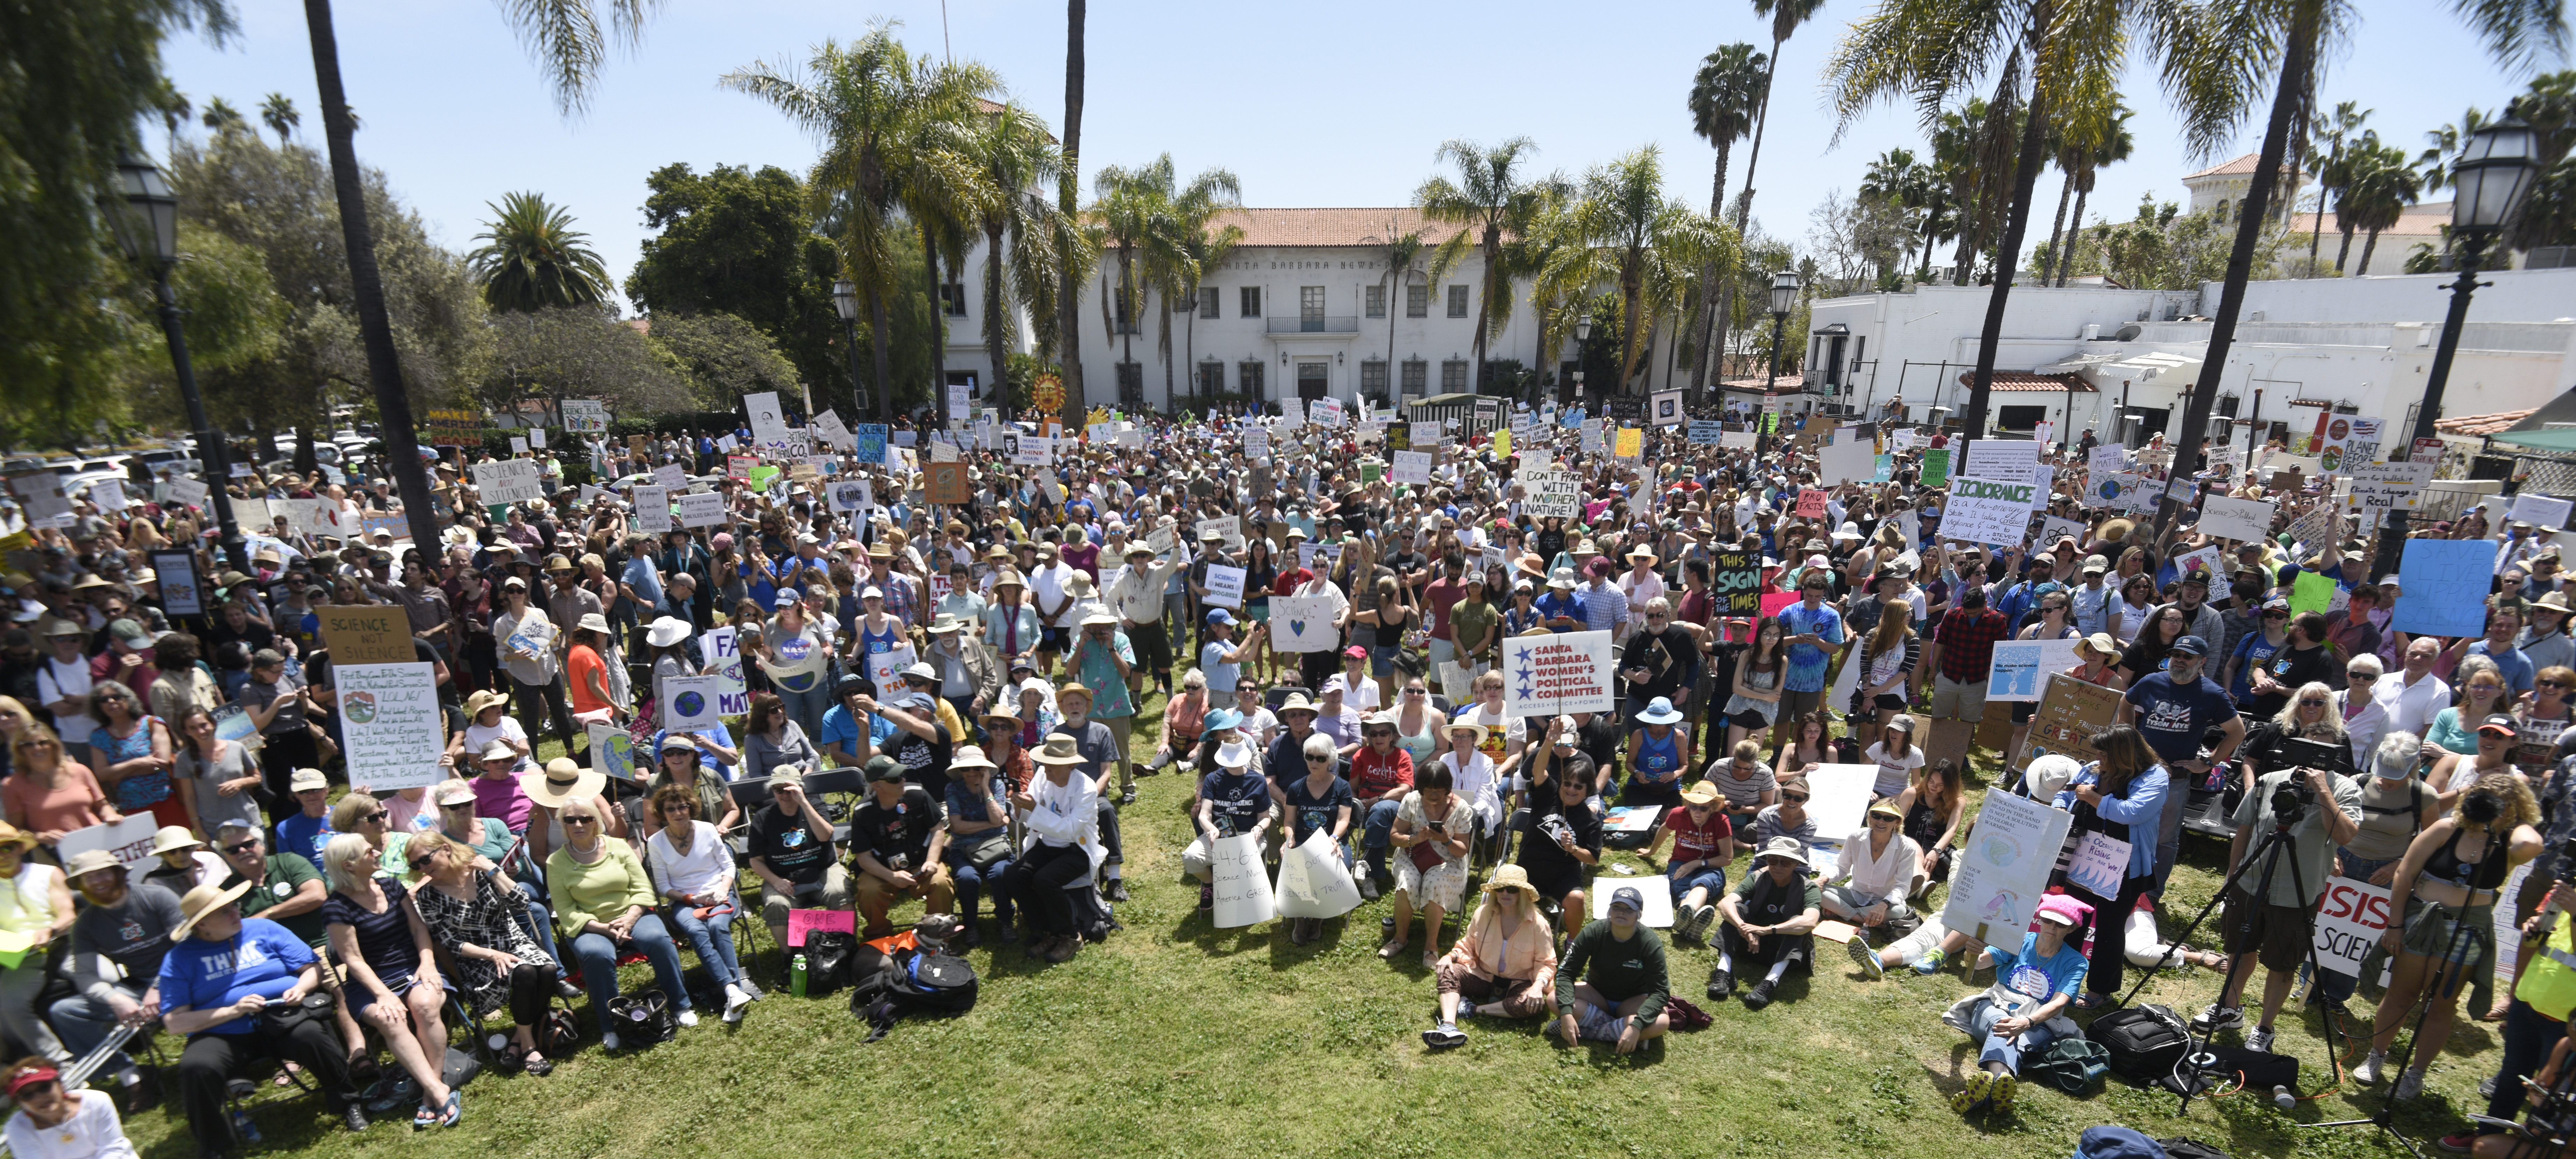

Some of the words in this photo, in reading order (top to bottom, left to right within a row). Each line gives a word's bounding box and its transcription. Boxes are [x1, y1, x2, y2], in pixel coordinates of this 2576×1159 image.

[1217, 262, 1259, 270] ANTA
[1272, 262, 1330, 271] BARBARA
[429, 410, 470, 420] MAKE
[429, 420, 481, 429] AMERICA
[860, 424, 887, 435] SCIENCE
[432, 429, 480, 437] SMART
[786, 431, 807, 444] BETTER
[432, 437, 481, 446] AGAIN
[2346, 440, 2381, 455] PLANET
[1928, 450, 1950, 458] SCIENCE
[2211, 446, 2232, 455] THINK!
[1396, 453, 1430, 465] SCIENCE
[479, 462, 527, 480] SCIENCE
[2355, 462, 2390, 472] Science
[1527, 471, 1557, 481] DON'T
[1561, 472, 1582, 482] FRACK
[2382, 474, 2414, 482] bullshit
[497, 479, 515, 487] NOT
[1542, 482, 1574, 493] WITH
[2140, 479, 2164, 492] There
[489, 485, 535, 503] SILENCE!
[1804, 493, 1822, 501] PRO
[1953, 479, 2036, 504] IGNORANCE
[2350, 485, 2376, 494] Climate
[2381, 486, 2410, 498] change
[1533, 493, 1576, 506] MOTHER
[1798, 501, 1823, 510] FACTS
[2366, 495, 2394, 507] Real
[1525, 504, 1572, 516] NATURE!
[1951, 498, 1958, 506] is
[1974, 499, 2028, 519] low-energy
[2131, 504, 2157, 515] Planet
[641, 521, 667, 529] Scientist
[1204, 521, 1233, 530] CLIMATE
[2245, 520, 2266, 536] Ideology
[1483, 547, 1499, 557] CLEAN
[2421, 541, 2486, 561] SAVE
[1719, 554, 1746, 568] THIS
[1750, 552, 1760, 561] IS
[1214, 573, 1238, 582] SCIENCE
[2417, 563, 2493, 582] LIVES
[1215, 581, 1234, 589] MEANS
[1717, 568, 1761, 592] SIGN
[2402, 580, 2486, 602] SUPPORT
[1277, 598, 1315, 618] SCIENCE
[1715, 604, 1730, 613] THE
[1728, 592, 1760, 611] TIMES
[2402, 604, 2485, 627] SCIENCE
[334, 618, 391, 632] SCIENCE
[362, 632, 384, 644] NOT
[345, 646, 409, 660] SILENCE
[783, 646, 811, 656] NASA
[1535, 644, 1572, 655] SANTA
[1535, 654, 1591, 666] BARBARA
[1535, 665, 1596, 677] WOMEN'S
[1536, 676, 1594, 688] POLITICAL
[1537, 686, 1603, 699] COMMITTEE
[2055, 678, 2068, 687] from
[2073, 684, 2112, 703] Redwoods
[2146, 718, 2170, 728] TYSON
[2043, 723, 2089, 746] GREAT
[1993, 797, 2018, 810] STICKING
[2018, 806, 2035, 816] YOUR
[1991, 802, 2006, 812] HEAD
[2012, 810, 2024, 818] THE
[2025, 814, 2040, 824] SAND
[1994, 810, 2005, 819] NOT
[2011, 816, 2039, 830] SOLUTION
[1994, 816, 2016, 829] GLOBAL
[1984, 819, 2011, 834] WARMING
[1679, 833, 1714, 844] SCIENCE
[1305, 853, 1322, 870] OUT
[1966, 865, 1981, 874] YOUR
[1961, 880, 1975, 890] STILL
[1963, 876, 1975, 884] WILL
[1320, 878, 1348, 896] TRUTH
[1955, 895, 1965, 904] HOT
[1957, 890, 1971, 900] VERY
[803, 912, 835, 925] ONE
[200, 939, 267, 973] THINK
